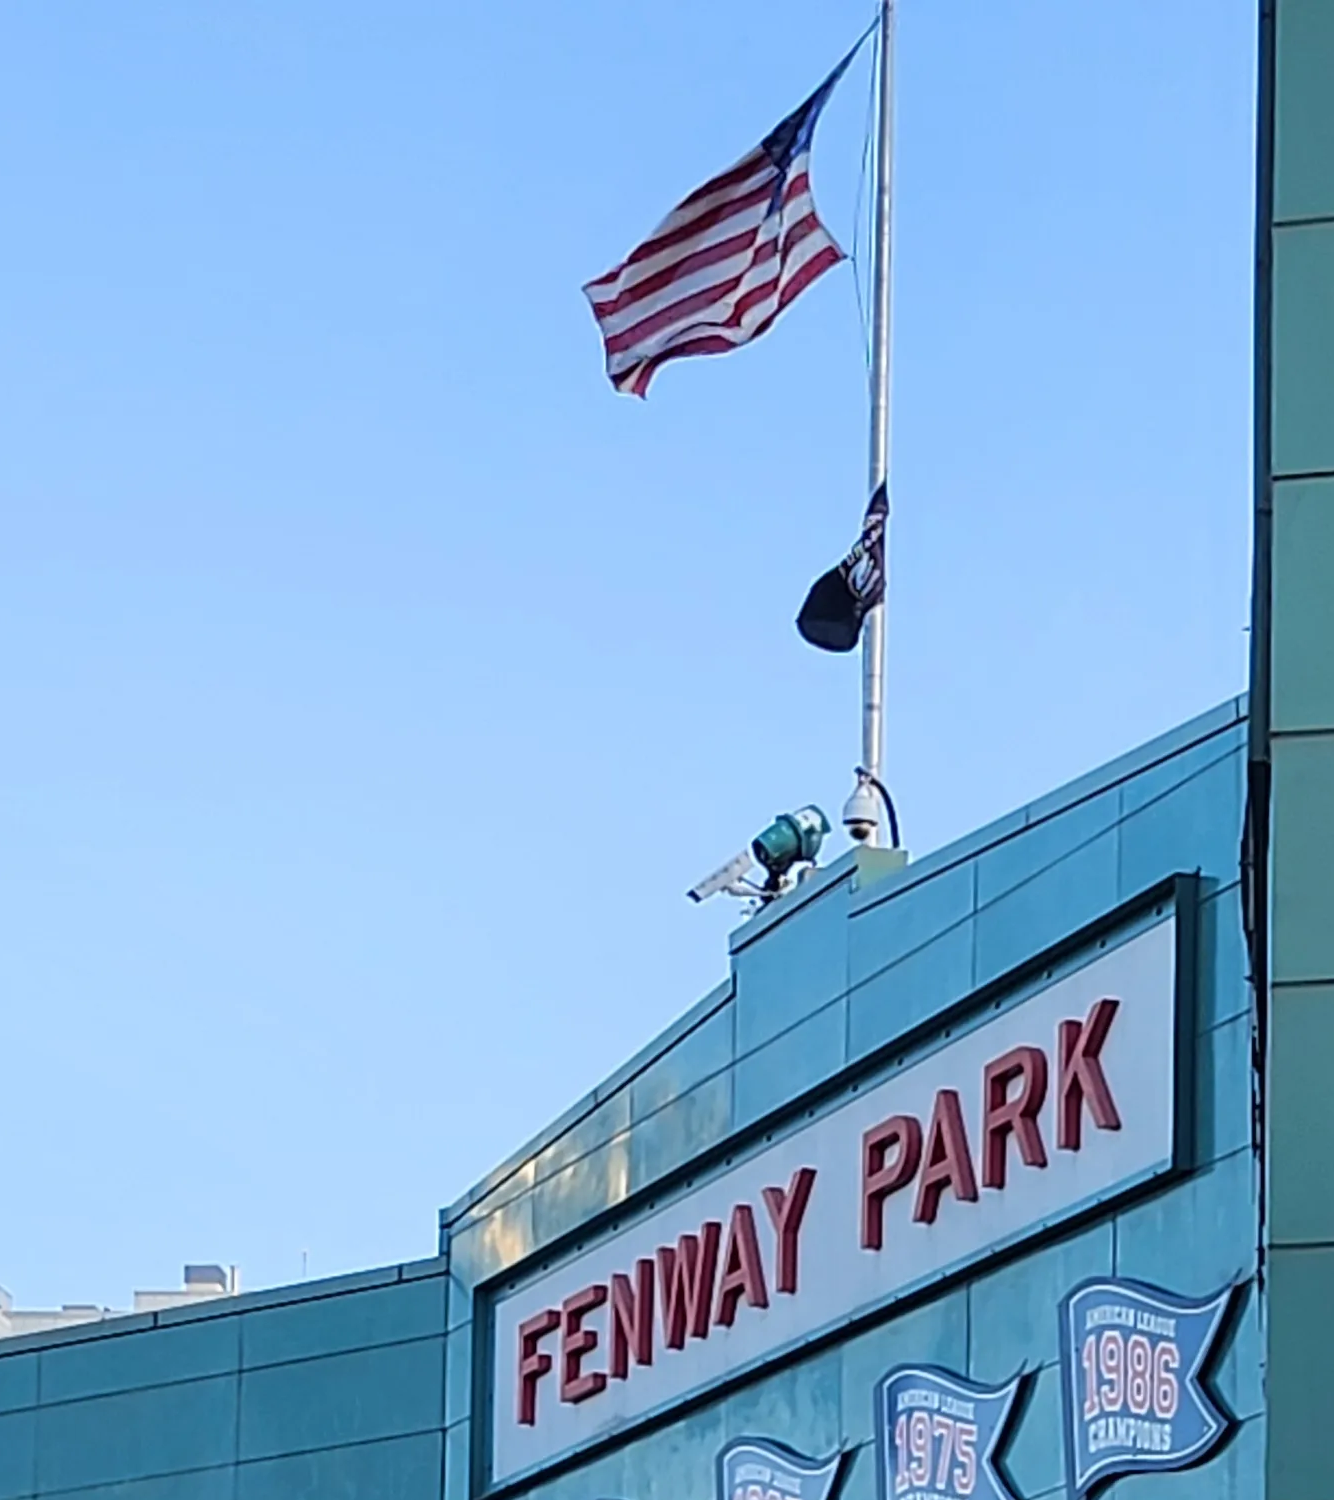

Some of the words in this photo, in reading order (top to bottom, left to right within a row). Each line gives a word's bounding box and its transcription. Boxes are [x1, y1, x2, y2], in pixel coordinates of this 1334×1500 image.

[518, 1168, 816, 1426] FENWAY
[861, 998, 1121, 1251] PARK
[1085, 1305, 1134, 1330] AMERICAN
[1137, 1310, 1176, 1337] LEAGUE
[1082, 1330, 1180, 1421] 1986
[895, 1411, 978, 1495] 1975
[1088, 1416, 1172, 1453] CHAMPIONS
